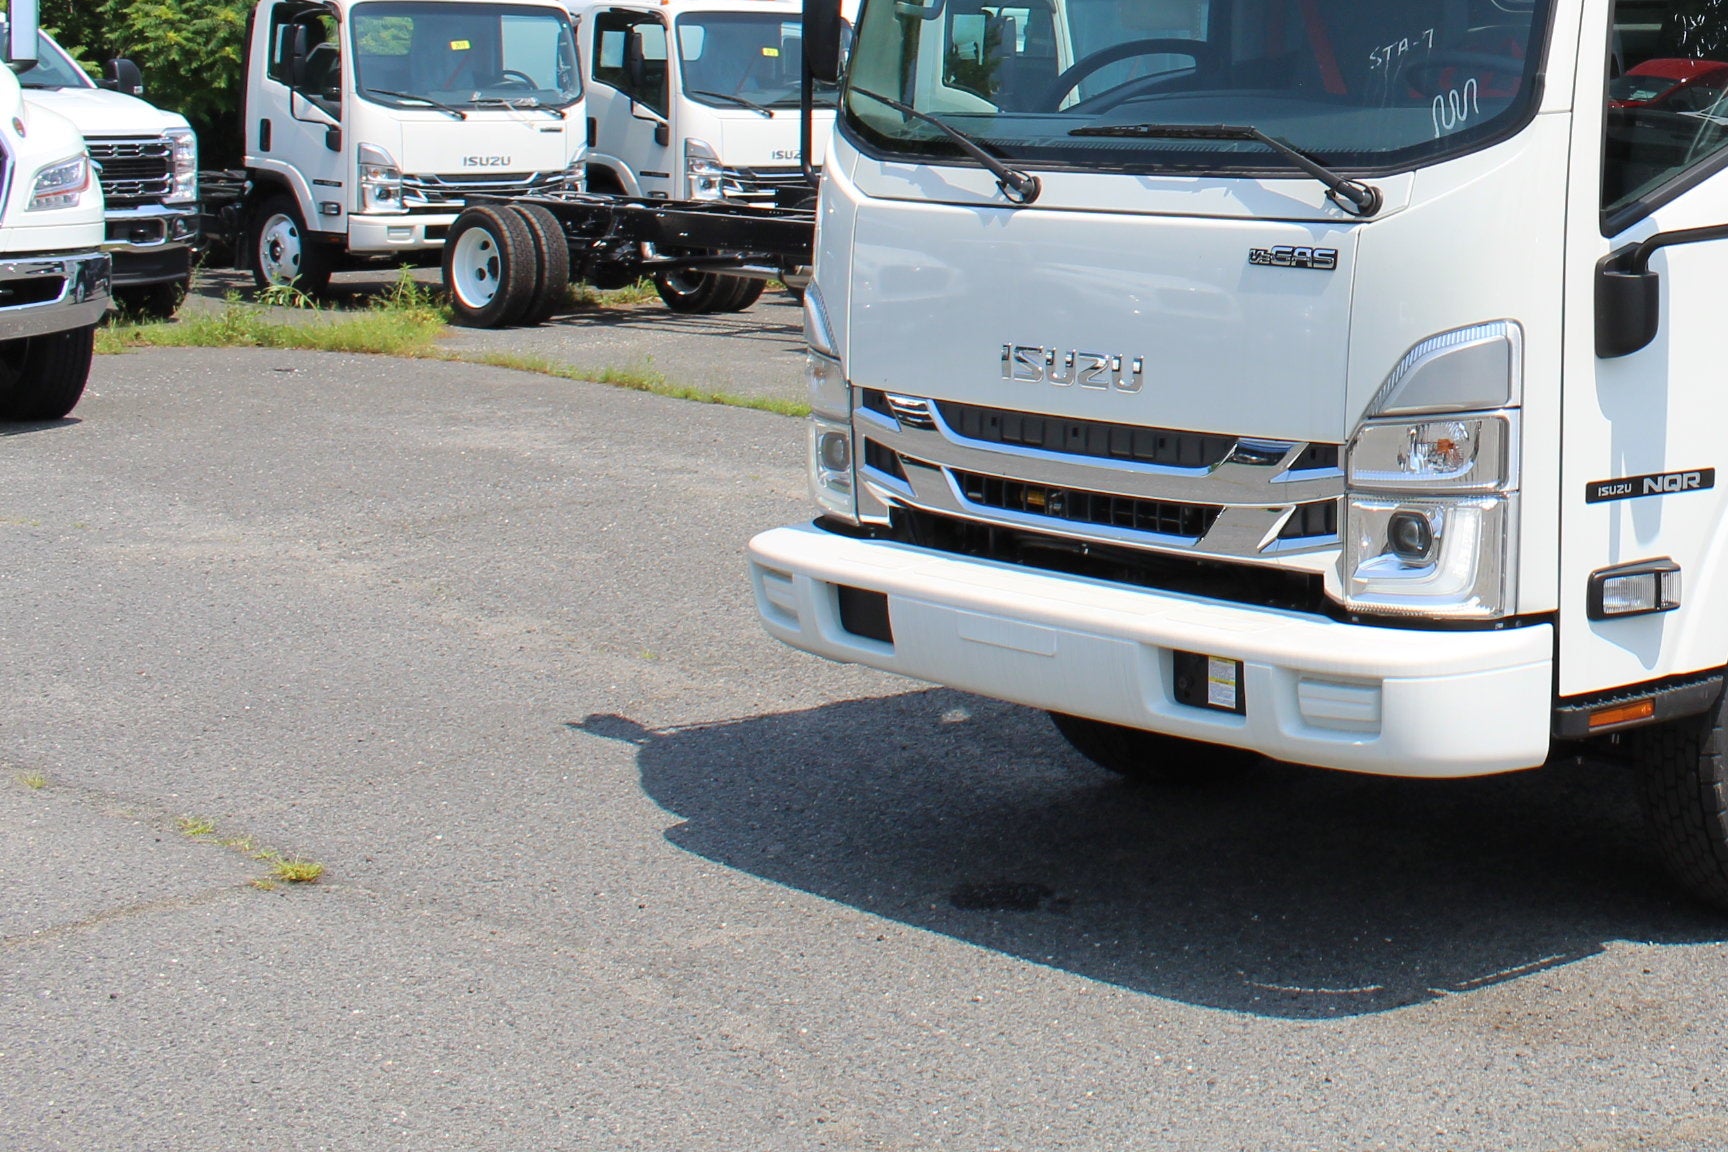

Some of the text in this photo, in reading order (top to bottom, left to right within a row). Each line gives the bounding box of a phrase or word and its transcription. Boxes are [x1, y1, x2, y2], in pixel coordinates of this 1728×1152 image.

[463, 155, 511, 167] ISUZU
[771, 150, 802, 160] ISUZ
[1270, 245, 1337, 270] GAS
[1001, 343, 1144, 394] ISUZU
[1598, 471, 1701, 497] ISUZU NQR
